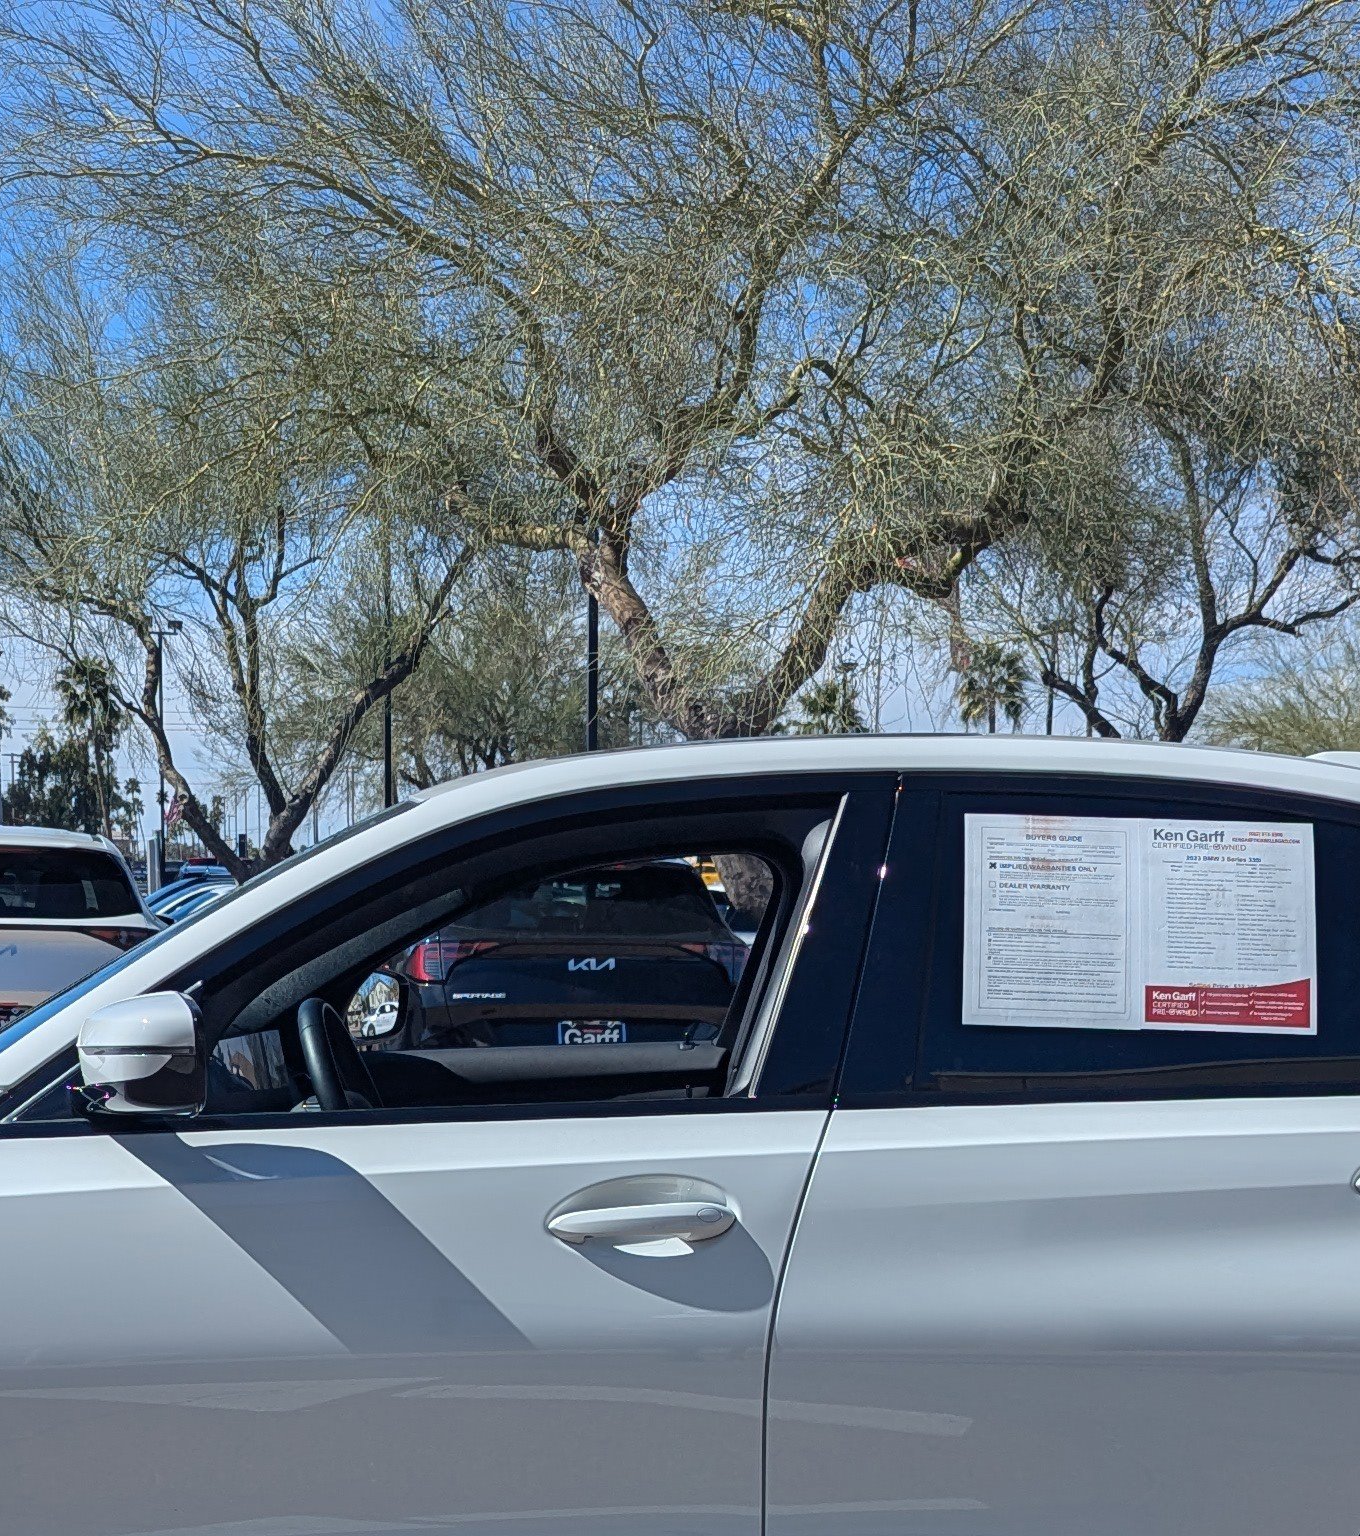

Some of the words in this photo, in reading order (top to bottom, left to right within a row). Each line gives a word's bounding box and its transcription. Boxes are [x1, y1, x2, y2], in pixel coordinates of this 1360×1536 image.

[1025, 834, 1057, 842] BUYERS
[1153, 829, 1183, 842] Ken
[1186, 830, 1225, 843] Garff
[1152, 842, 1192, 850] CERTIFIED
[1194, 843, 1246, 851] PRE-OWNED
[999, 863, 1028, 871] IMPLIED
[1029, 864, 1077, 872] WARRANTIES
[1078, 865, 1098, 873] ONLY
[1029, 883, 1071, 891] WARRANTY
[568, 957, 616, 971] KIA
[1152, 991, 1172, 1000] Ken
[1172, 992, 1196, 1001] Garff
[1152, 1001, 1189, 1009] CERTIFIED
[564, 1028, 620, 1044] Garff
